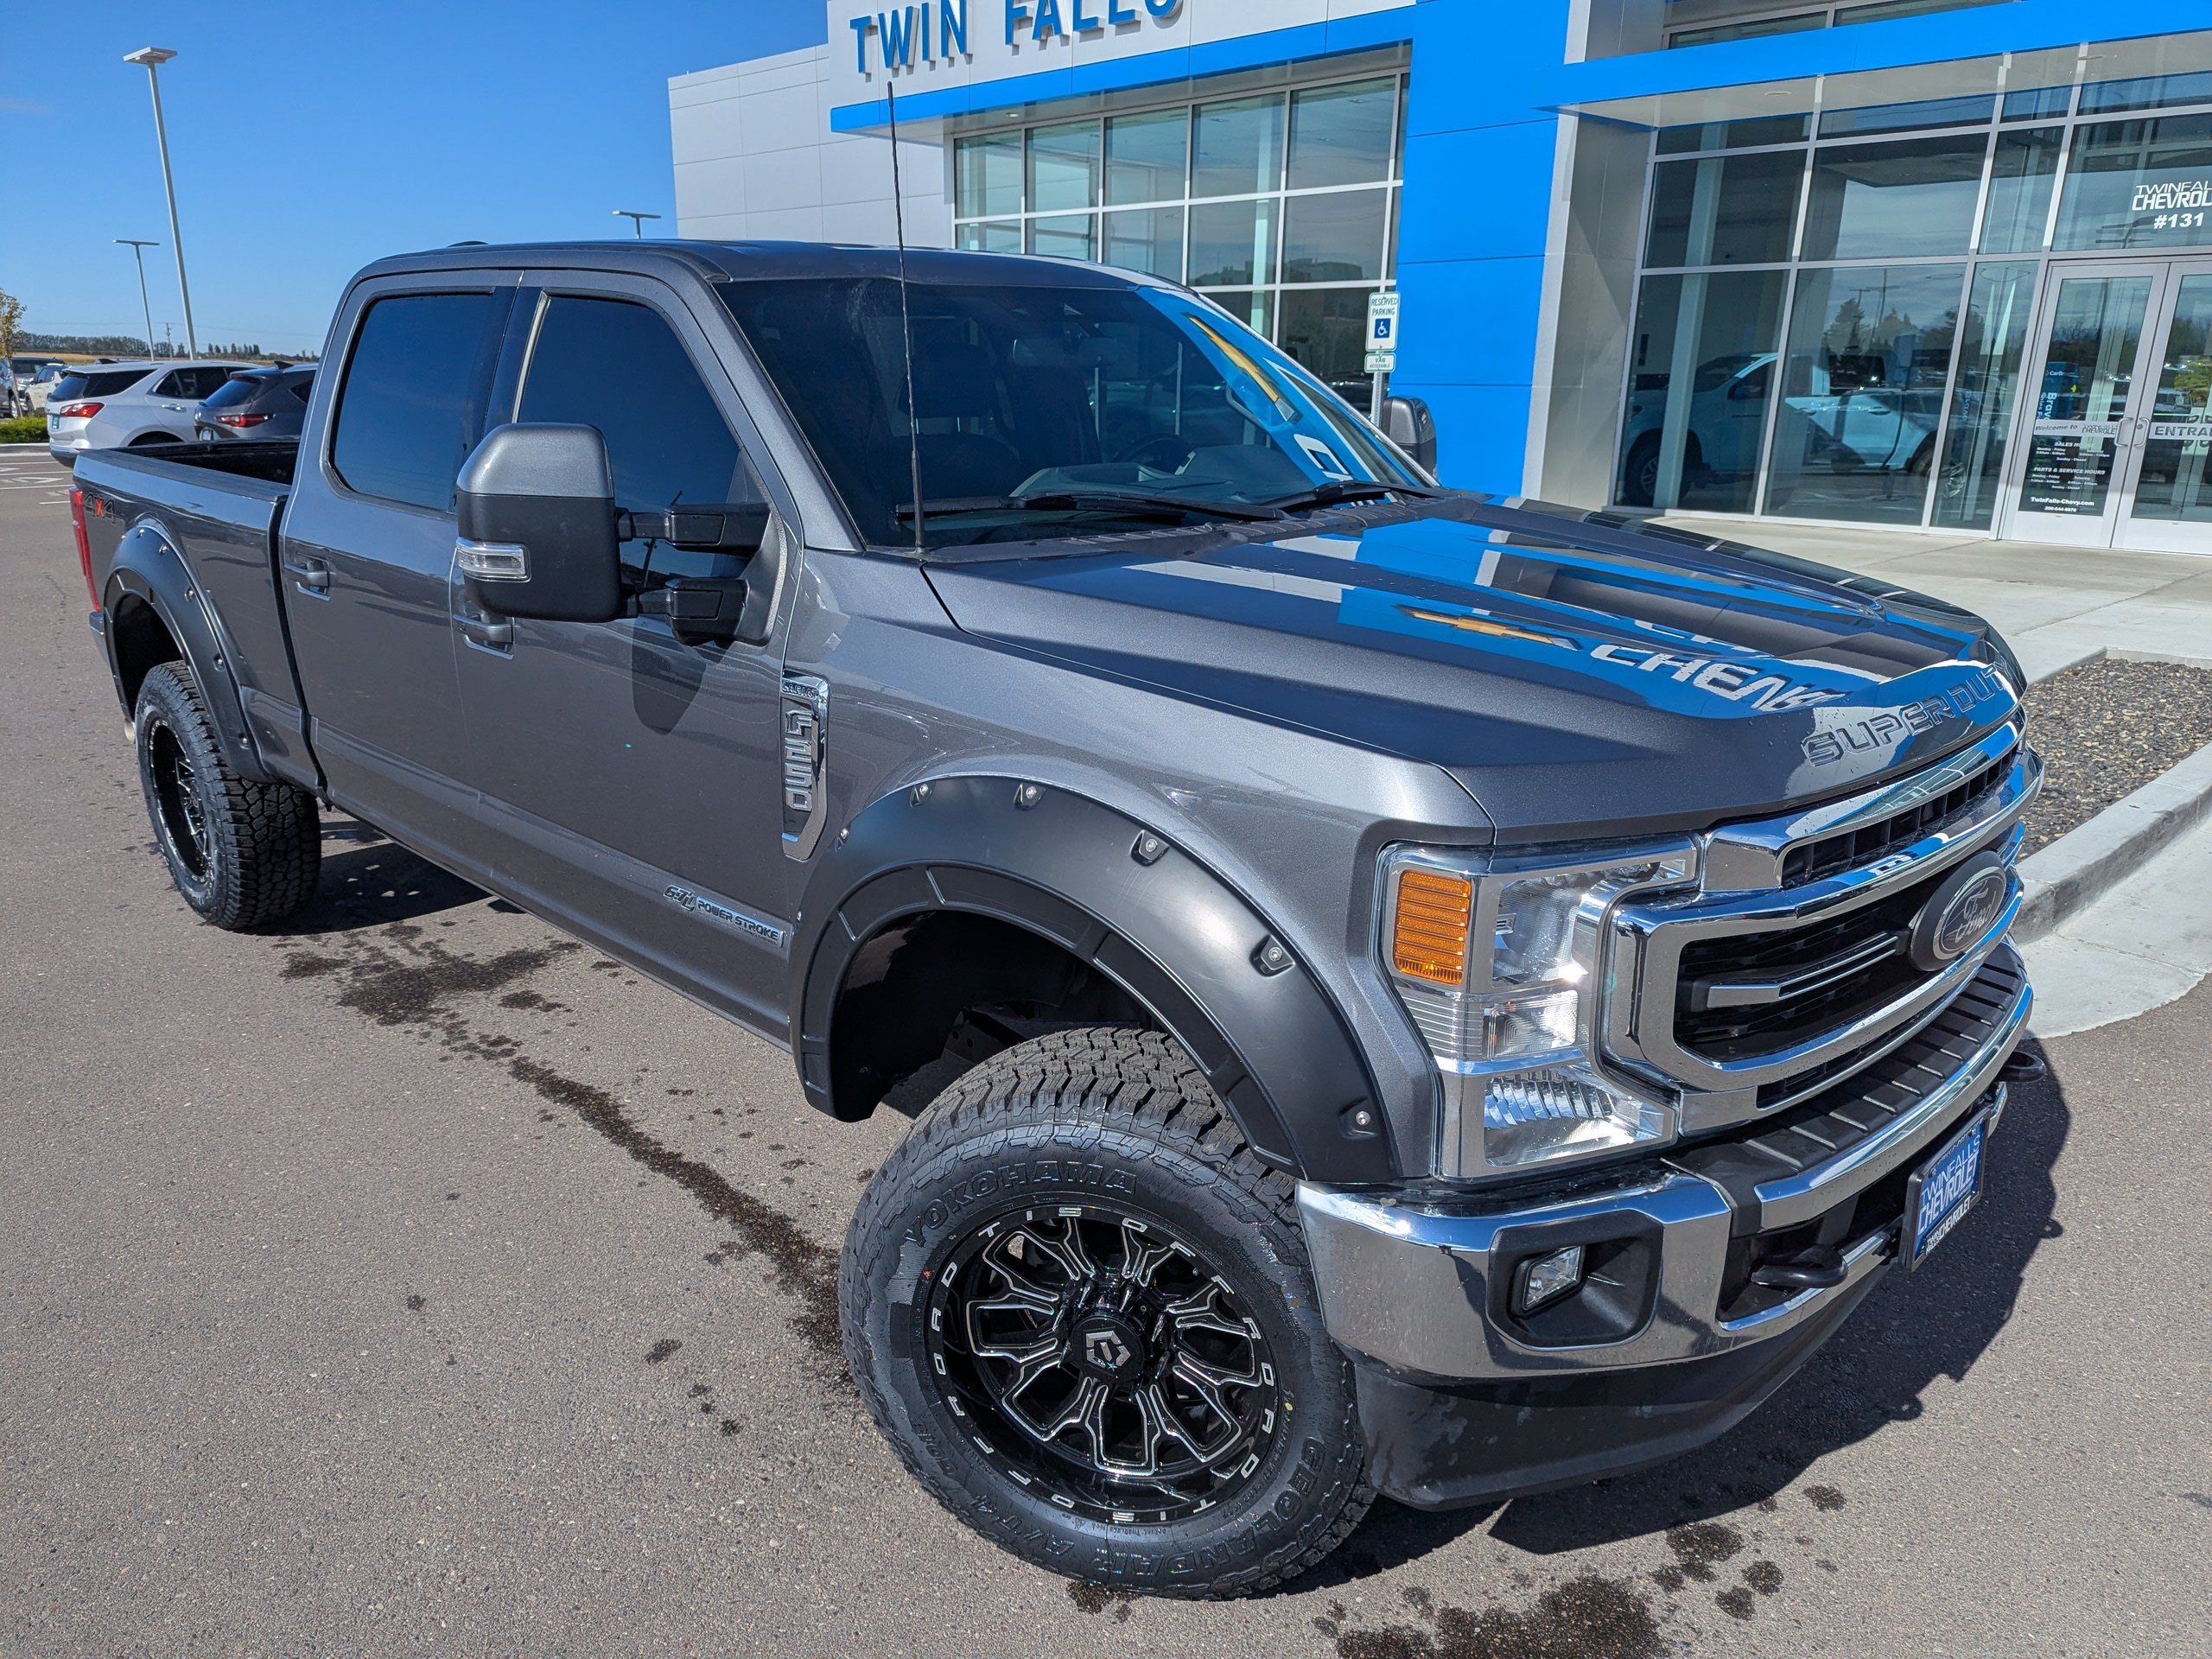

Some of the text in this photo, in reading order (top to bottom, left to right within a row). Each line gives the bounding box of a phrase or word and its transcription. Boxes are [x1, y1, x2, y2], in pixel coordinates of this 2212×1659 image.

[850, 0, 968, 73] TWIN
[2153, 213, 2204, 229] #131
[1370, 297, 1398, 306] RESERVED
[1371, 308, 1395, 316] PARKING
[2154, 426, 2212, 436] ENTRA
[2031, 496, 2094, 506] TwinFalls-Chevy.com
[1801, 655, 2013, 767] SUPER DUTY
[697, 899, 733, 923] POWER
[734, 916, 779, 942] STROKE
[1948, 886, 1998, 944] Ford
[1917, 1149, 1980, 1236] CHEVROLET
[1921, 1135, 1980, 1206] TWINFALLS
[904, 1160, 1137, 1247] YOKOHAMA
